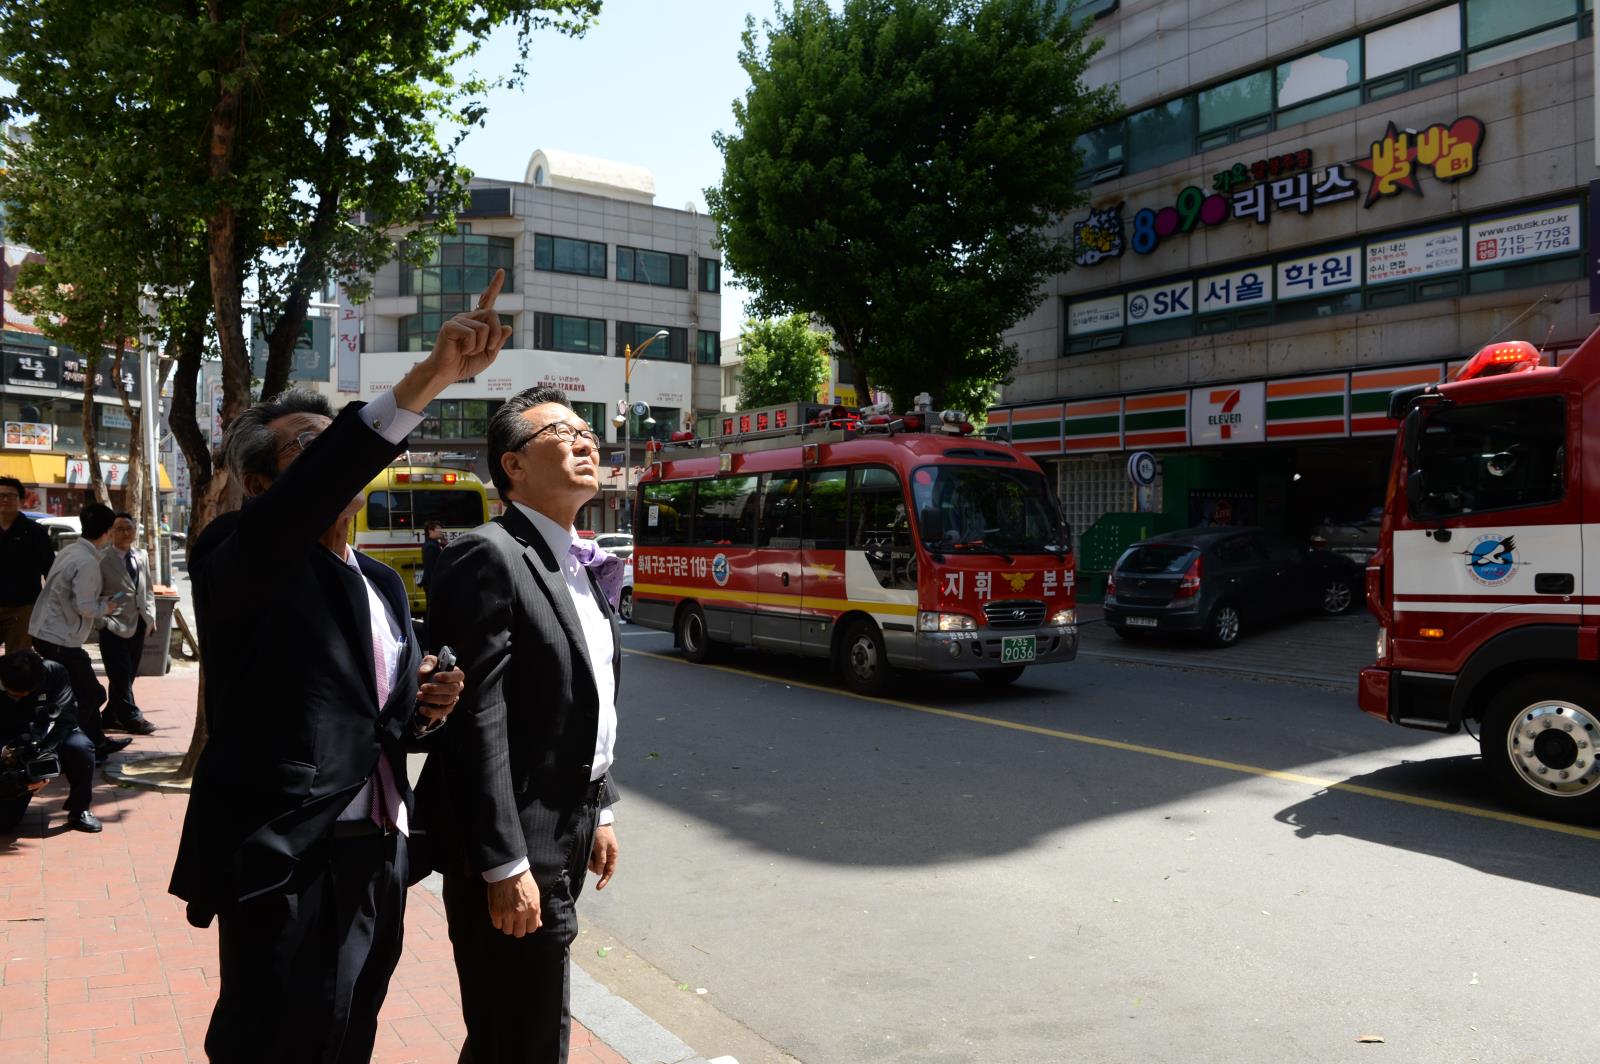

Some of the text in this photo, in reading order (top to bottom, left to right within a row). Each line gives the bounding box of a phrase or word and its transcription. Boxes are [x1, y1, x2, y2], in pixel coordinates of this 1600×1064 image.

[1372, 126, 1473, 194] 별밤
[1451, 157, 1469, 172] B1
[1213, 163, 1247, 192] 가요
[1232, 164, 1356, 224] 리믹스
[1478, 214, 1569, 238] www.edusk.co.kr
[1500, 226, 1570, 246] 715-7753
[1500, 237, 1570, 256] 715-7754
[1153, 255, 1353, 316] SK 서울 학원
[1210, 389, 1241, 440] 7
[690, 556, 707, 578] 119
[944, 570, 1075, 600] 지휘 본부
[1005, 646, 1034, 660] 9036
